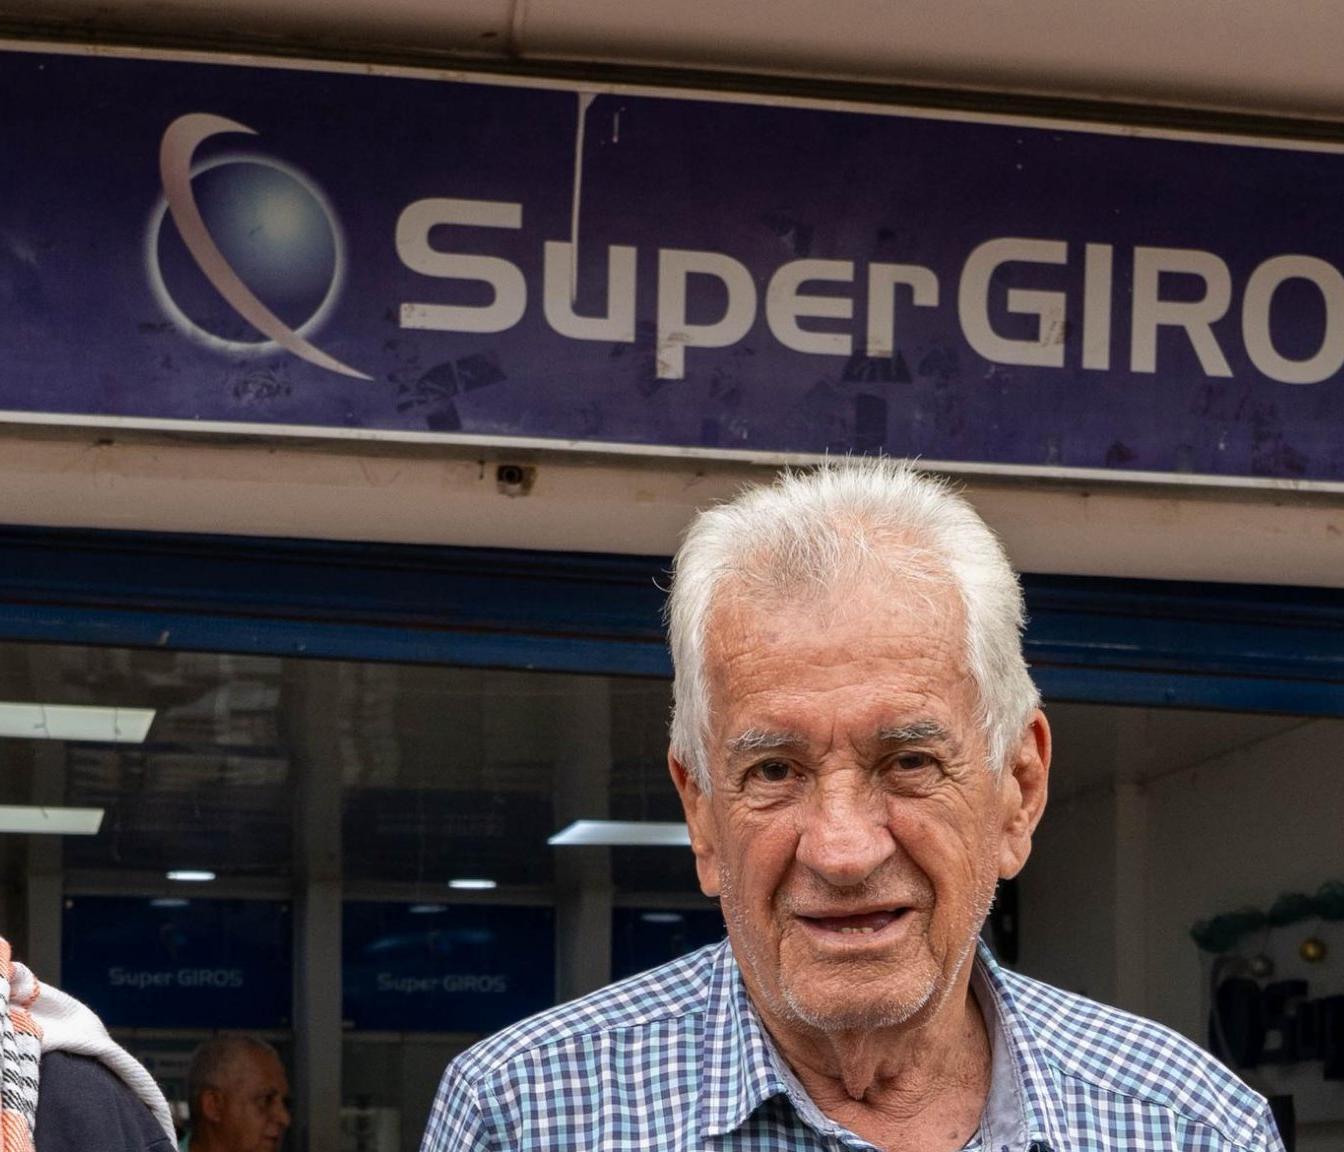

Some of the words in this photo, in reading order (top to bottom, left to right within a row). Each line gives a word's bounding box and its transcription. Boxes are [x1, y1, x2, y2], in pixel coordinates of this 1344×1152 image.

[109, 967, 173, 990] Super
[178, 967, 244, 988] GIROS
[443, 973, 507, 993] GIROS
